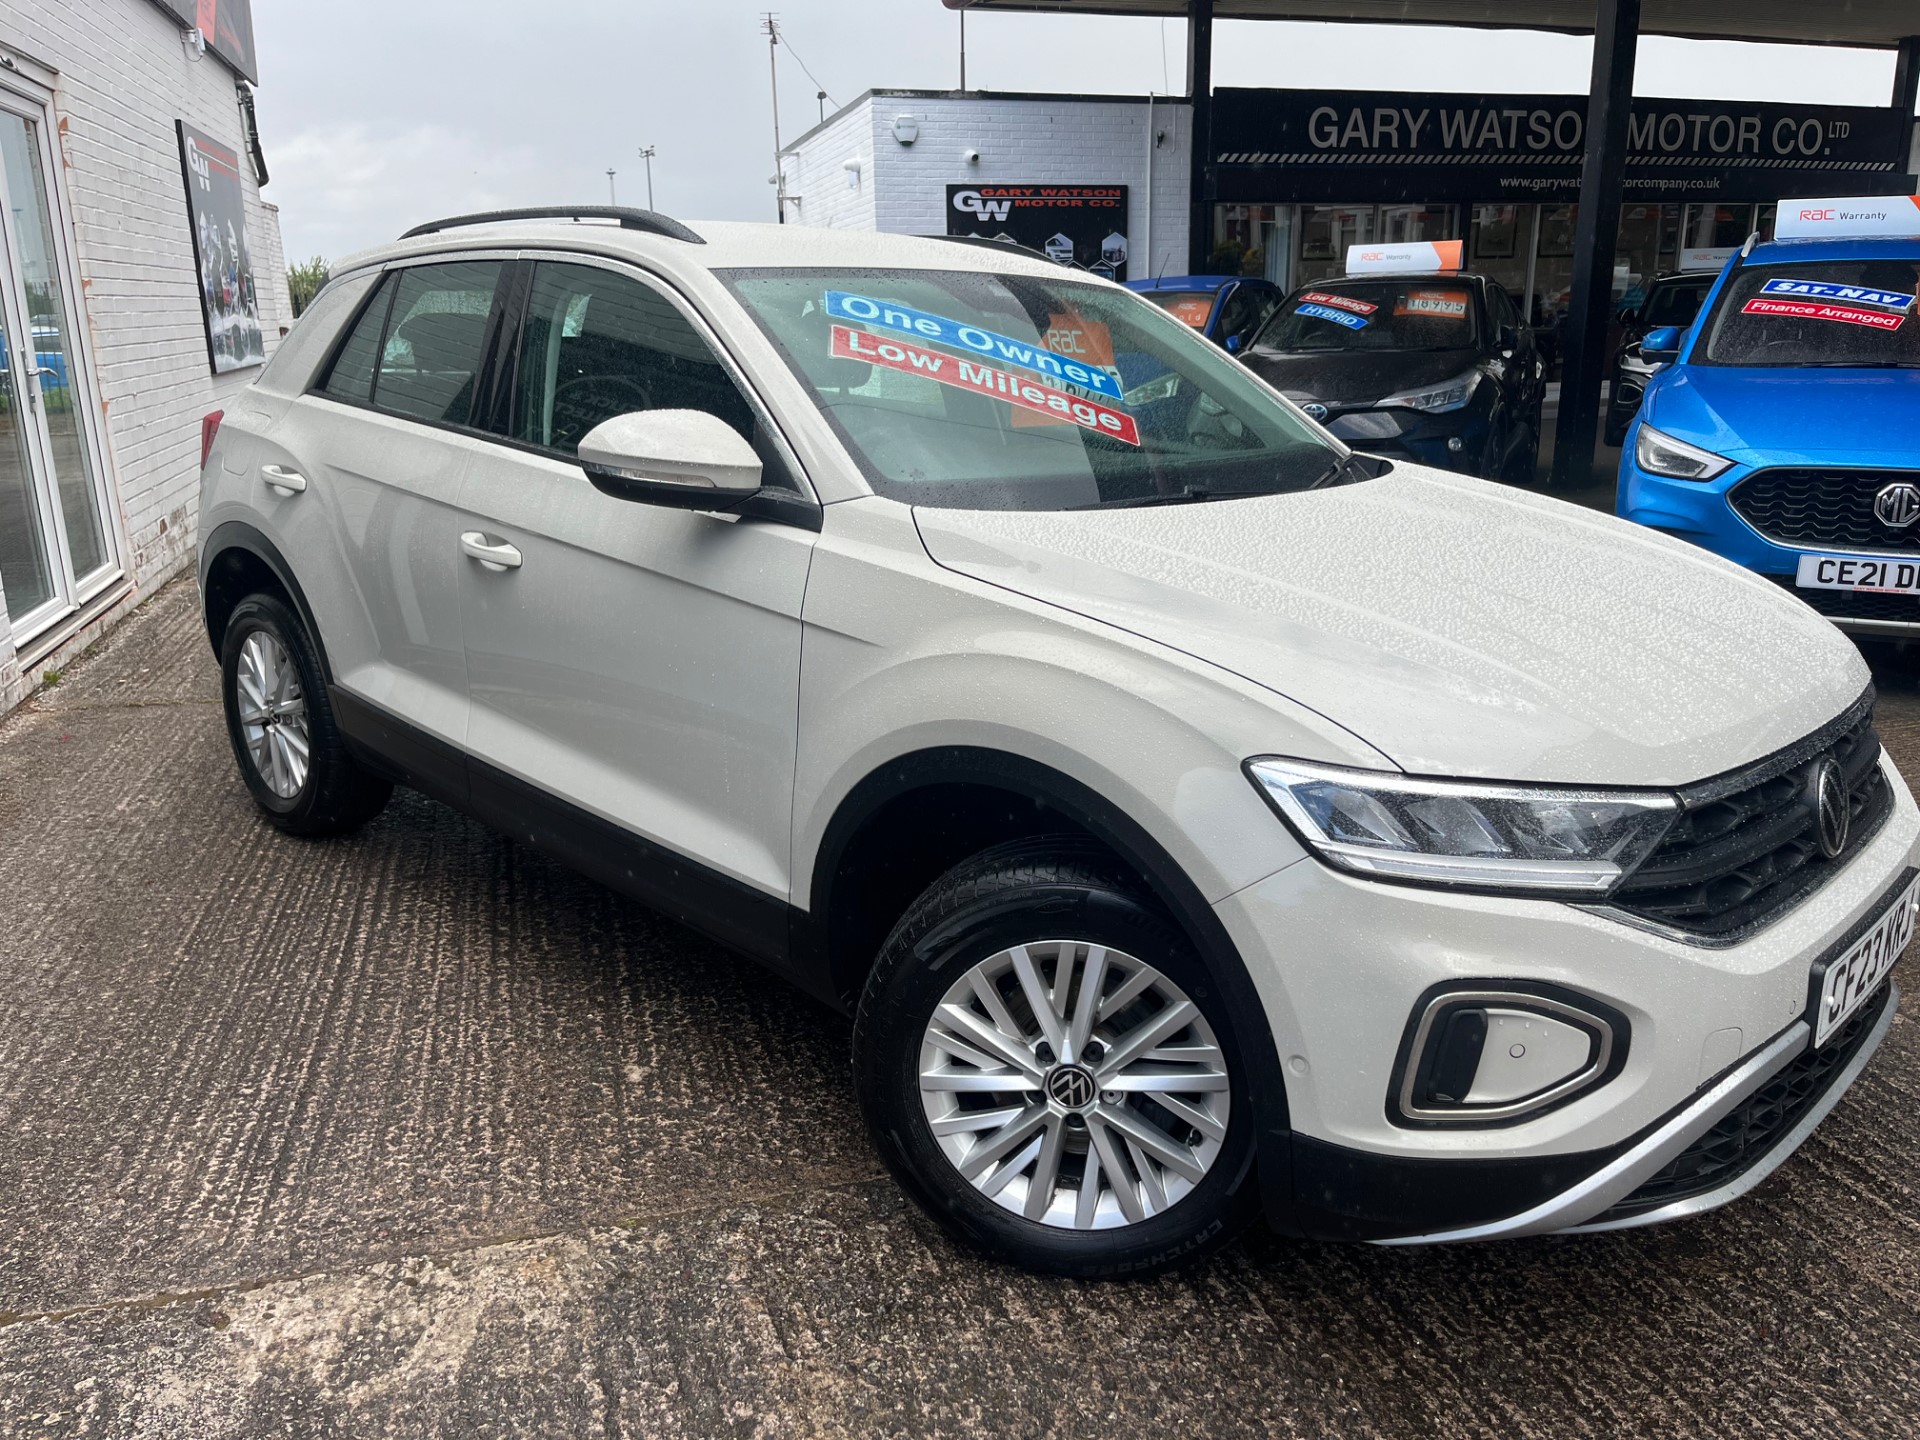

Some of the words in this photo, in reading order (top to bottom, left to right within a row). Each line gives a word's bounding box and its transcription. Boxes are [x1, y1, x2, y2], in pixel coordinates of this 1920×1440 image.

[1308, 106, 1430, 149] GARY
[1440, 108, 1583, 151] WATSO
[1626, 112, 1762, 153] MOTOR
[1772, 117, 1830, 156] CO.
[1828, 120, 1850, 139] LTD
[980, 188, 1034, 197] GARY
[1041, 188, 1121, 197] WATSON
[1014, 199, 1083, 207] MOTOR
[953, 190, 1012, 222] GW
[1839, 211, 1888, 221] Warranty
[1385, 253, 1412, 262] Warranty
[1306, 293, 1330, 302] Low
[1330, 296, 1371, 311] Mileage
[1773, 282, 1902, 304] SAT-NAV
[1304, 305, 1358, 326] HYBRID
[1750, 302, 1816, 314] Finance
[1817, 309, 1897, 327] Arranged
[841, 298, 943, 337] One
[957, 327, 1107, 390] Owner
[849, 332, 943, 373] Low
[958, 361, 1123, 433] Mileage
[1880, 487, 1920, 523] MG
[1816, 560, 1887, 587] CE21
[1895, 564, 1920, 590] D
[1828, 926, 1884, 1024] CF23
[1880, 887, 1916, 969] KRJ
